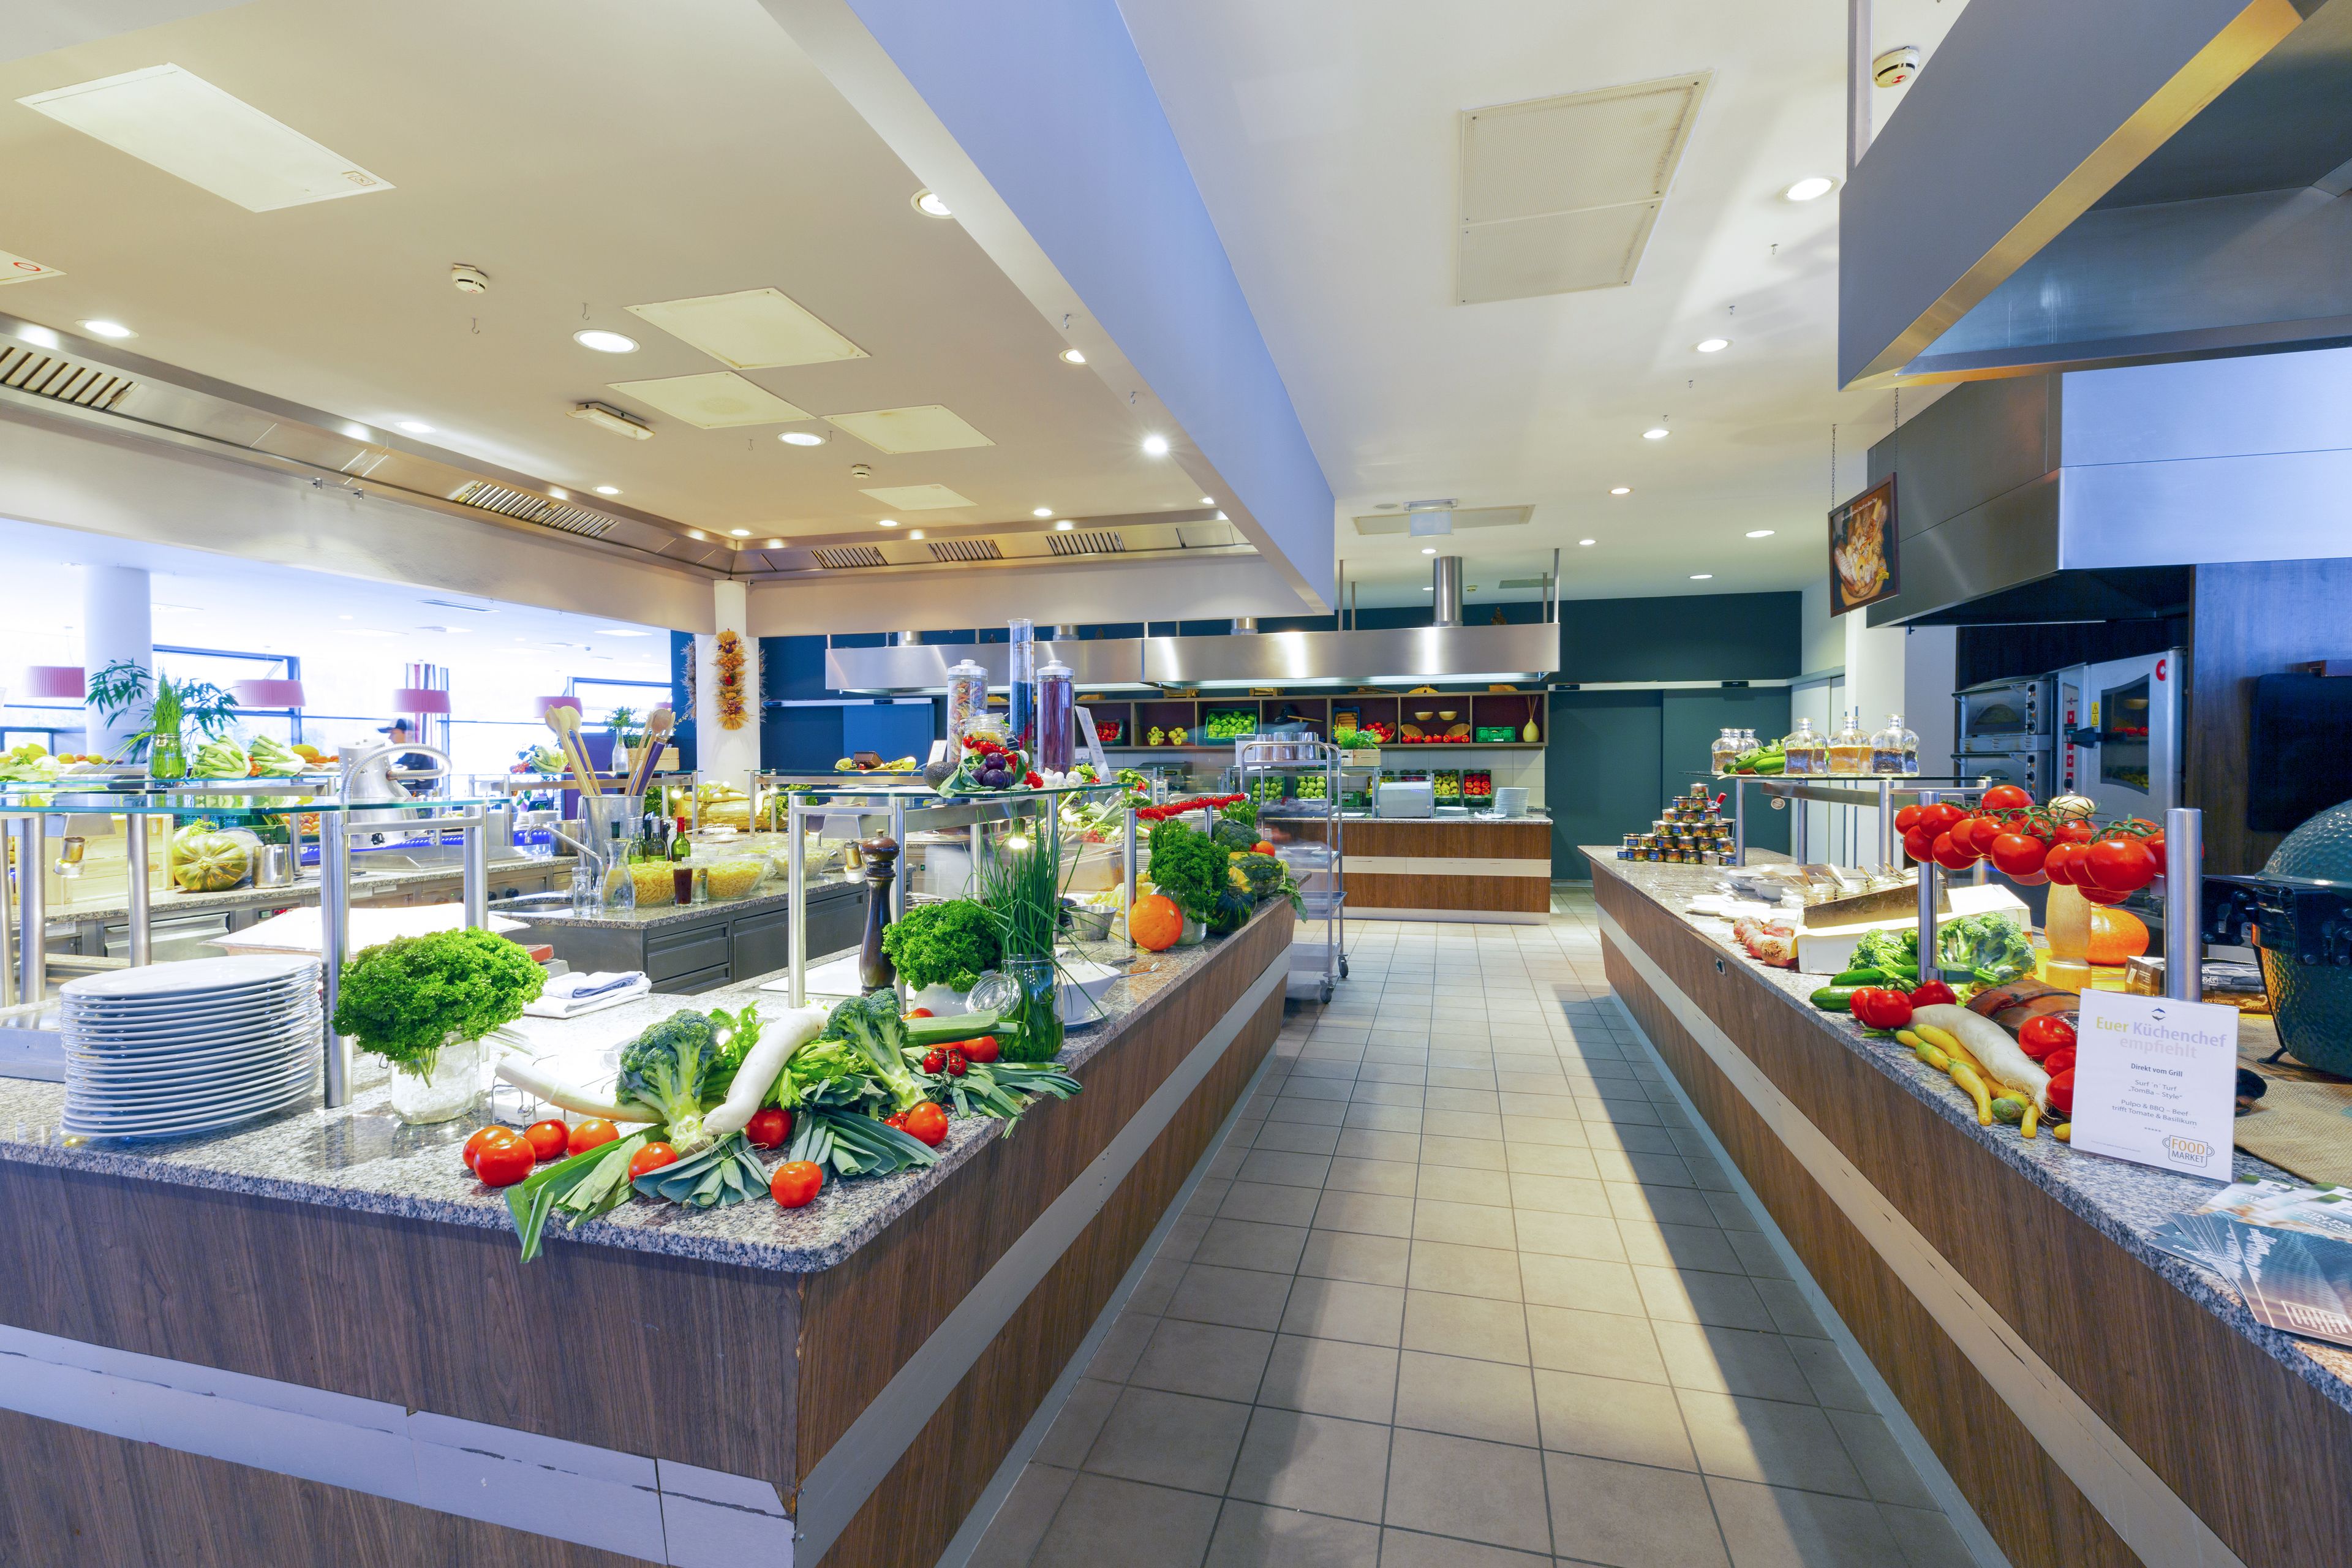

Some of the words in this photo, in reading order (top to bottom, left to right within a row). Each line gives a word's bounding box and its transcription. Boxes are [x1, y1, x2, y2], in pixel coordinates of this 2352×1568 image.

[2096, 1016, 2129, 1033] Euer
[2133, 1022, 2227, 1047] Küchenchef
[2120, 1038, 2197, 1059] empfiehlt
[2131, 1063, 2151, 1072] Direkt
[2121, 1099, 2141, 1108] Pulpo
[2149, 1104, 2165, 1113] BBQ
[2128, 1108, 2154, 1118] Tomate
[2163, 1114, 2197, 1126] Basilikum
[2171, 1138, 2205, 1155] FOOD
[2171, 1151, 2205, 1163] MARKET
